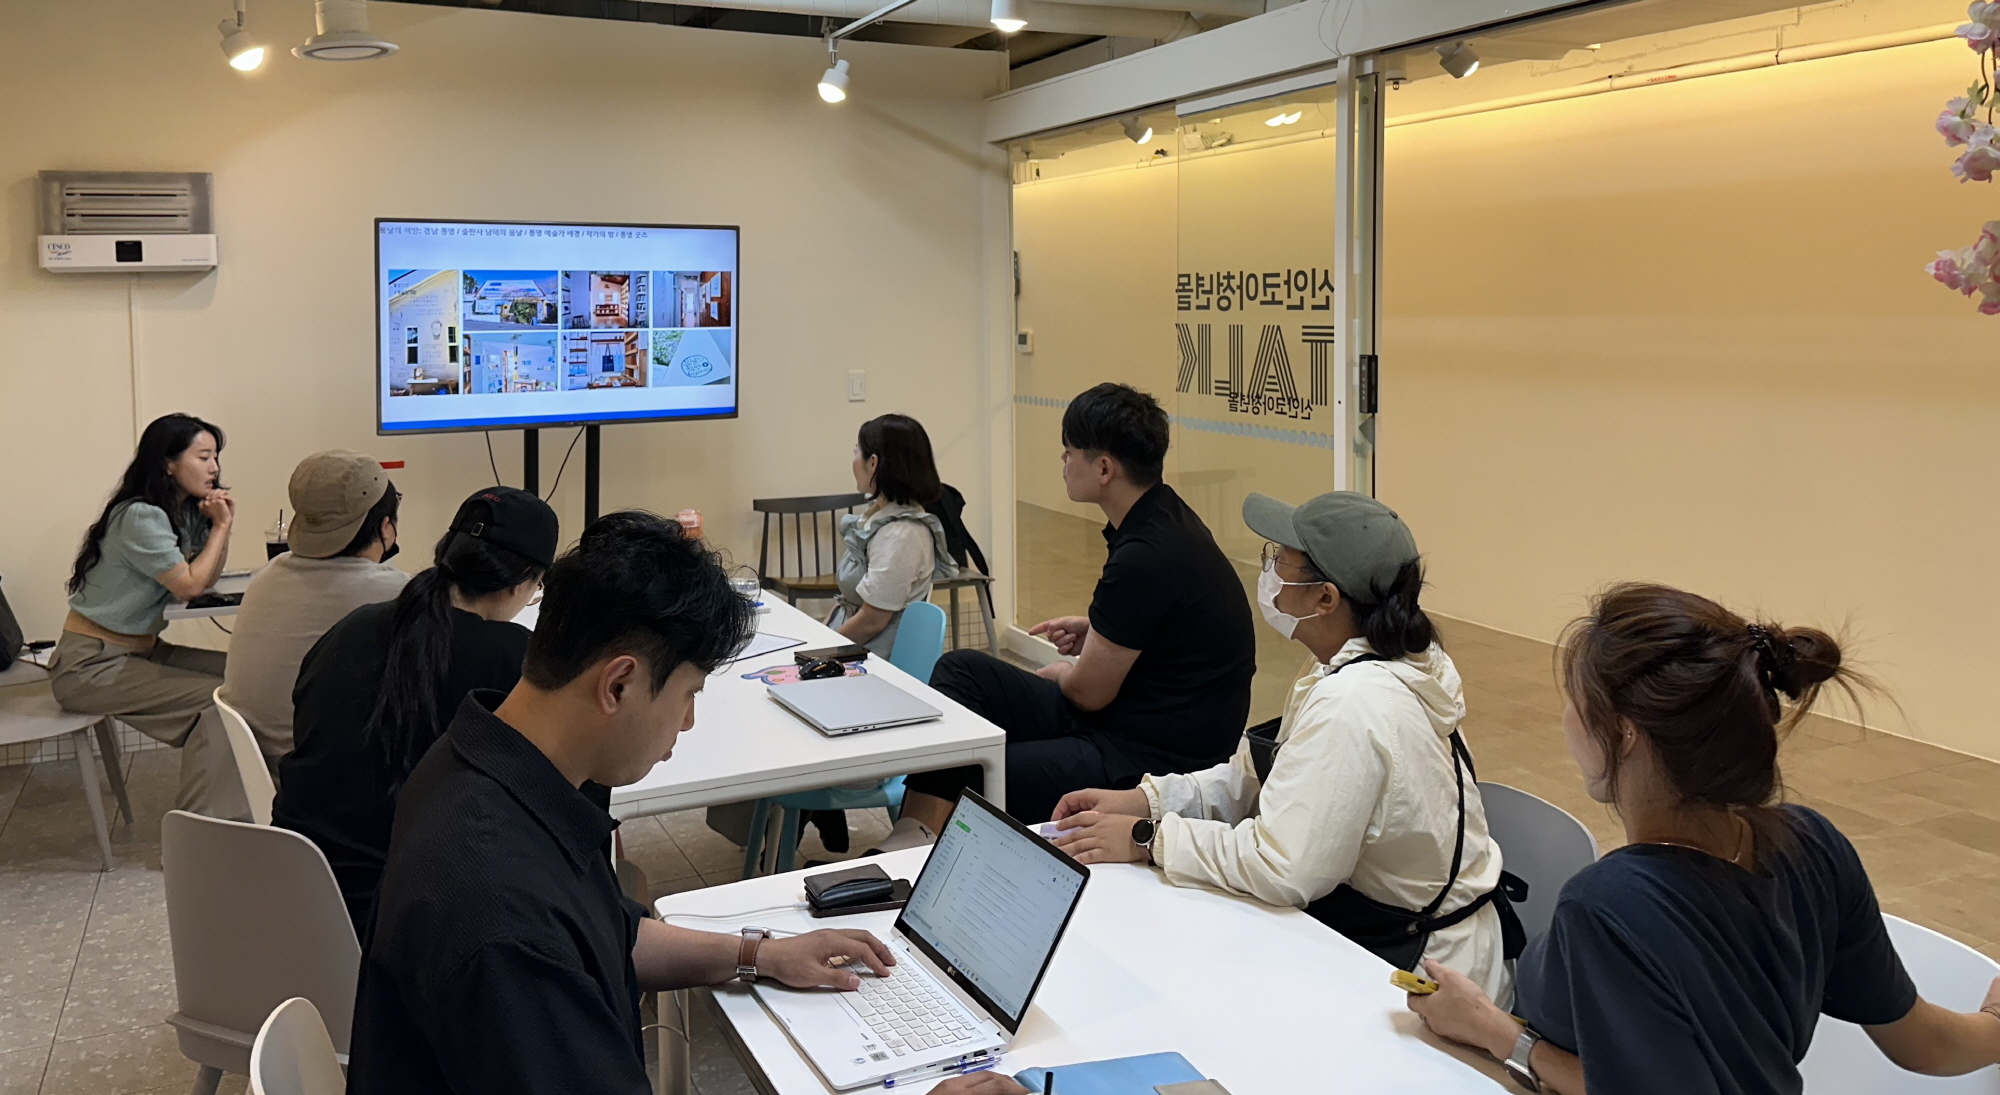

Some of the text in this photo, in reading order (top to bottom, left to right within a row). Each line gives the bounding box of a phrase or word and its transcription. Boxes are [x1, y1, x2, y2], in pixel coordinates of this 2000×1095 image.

[424, 227, 439, 236] 경남
[441, 227, 455, 236] 통영
[461, 228, 483, 236] 출판사
[485, 228, 507, 237] 남해의
[529, 229, 542, 237] 통영
[544, 229, 565, 238] 예술가
[567, 230, 580, 238] 배경
[586, 230, 606, 238] 작가의
[620, 231, 633, 239] 통영
[634, 231, 648, 239] 굿즈
